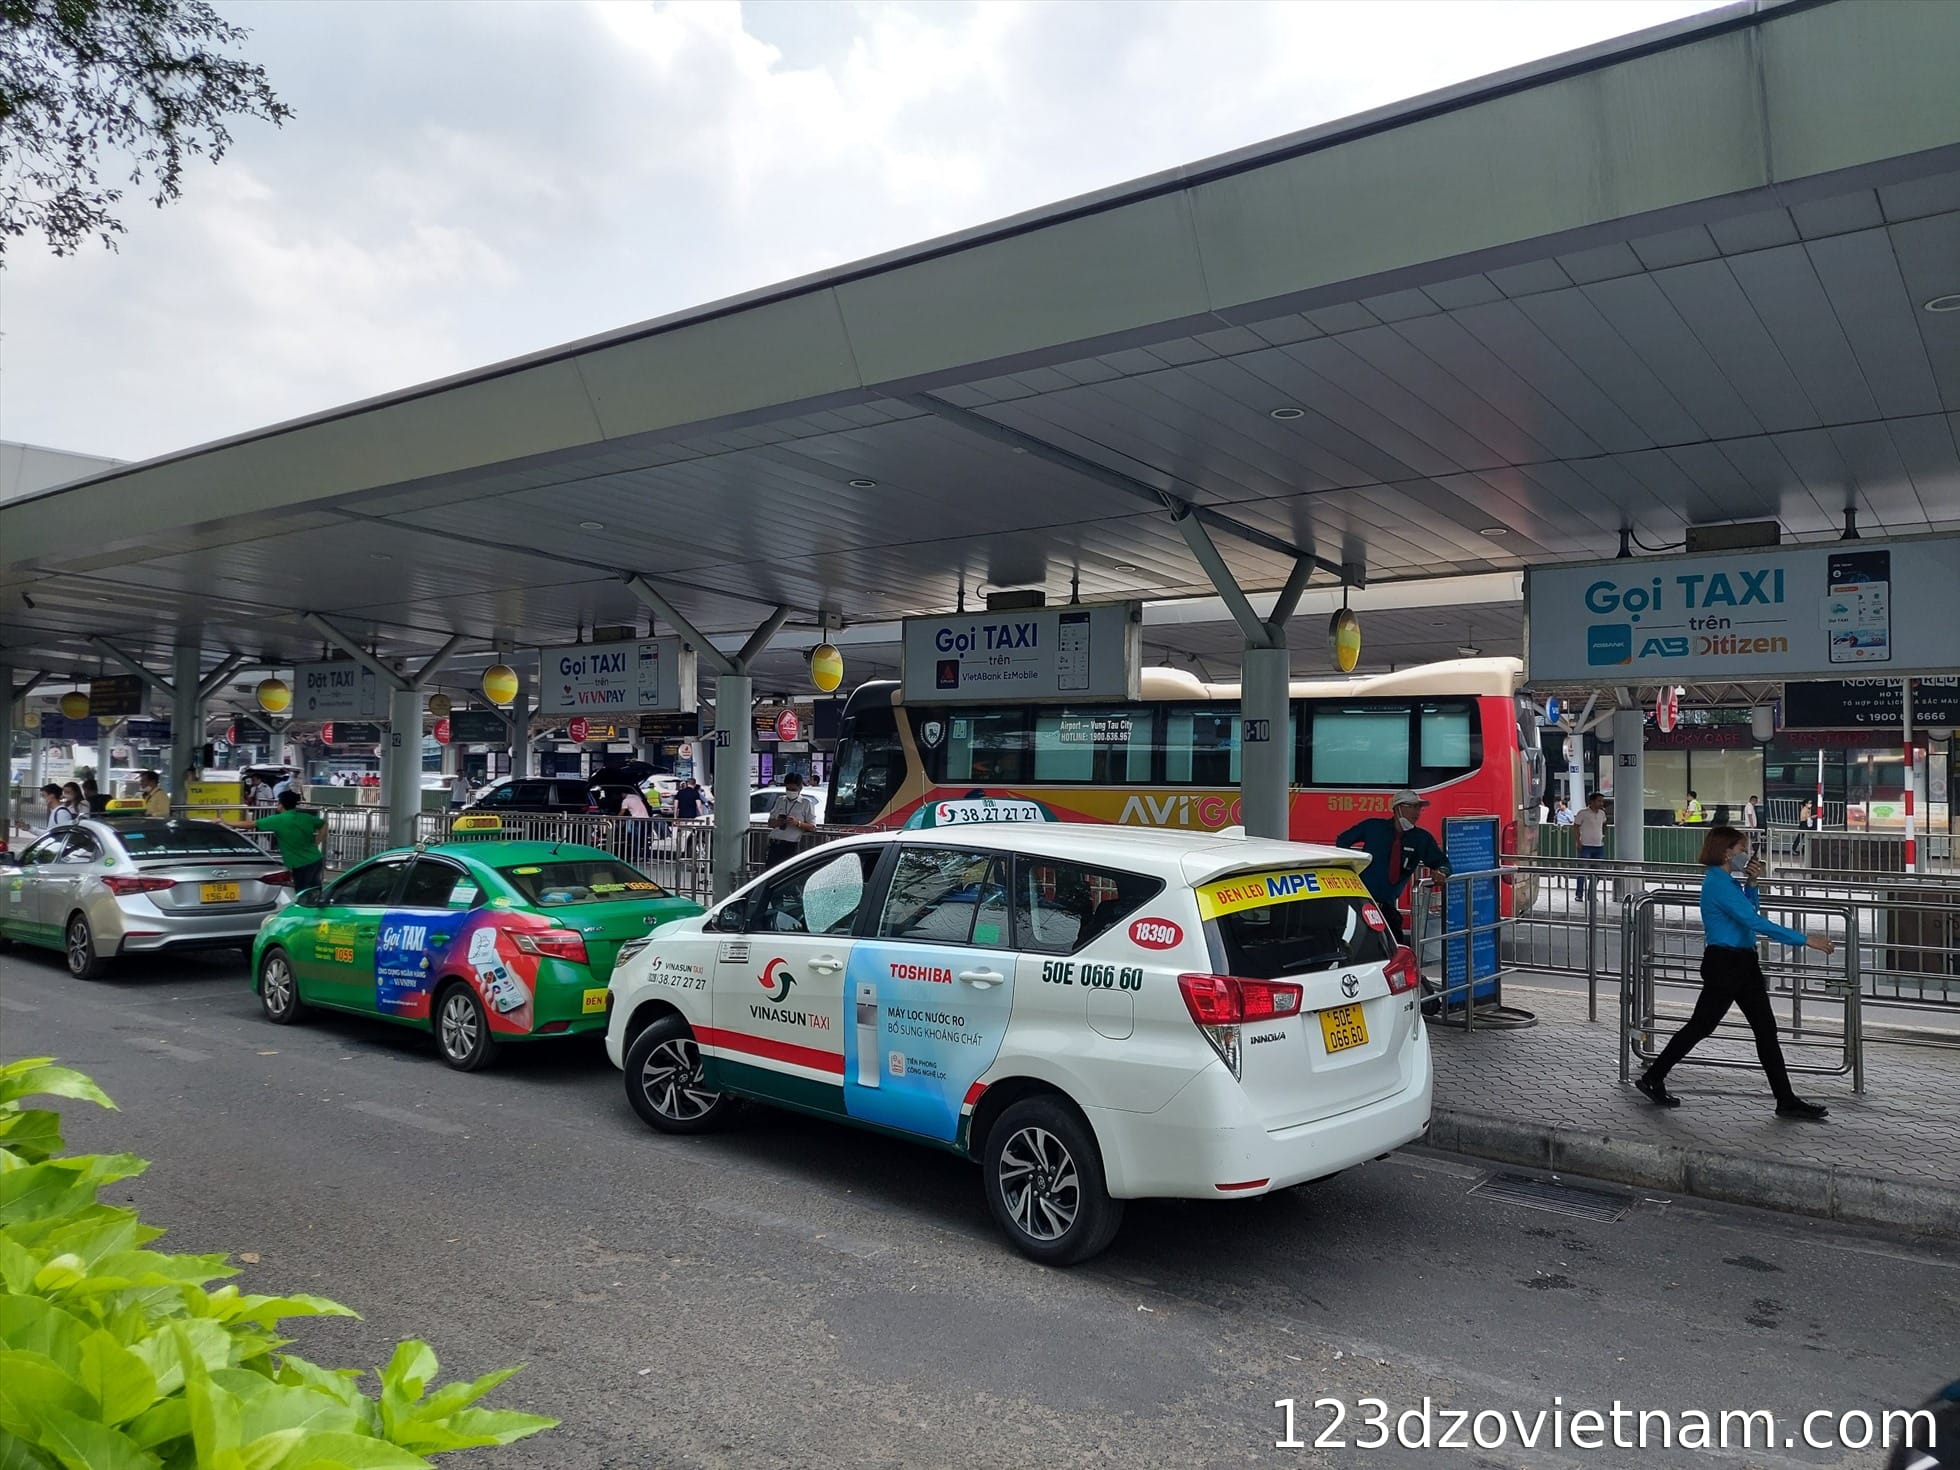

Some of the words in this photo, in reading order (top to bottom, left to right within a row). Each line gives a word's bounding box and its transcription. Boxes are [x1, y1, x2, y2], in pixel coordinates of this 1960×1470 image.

[1584, 577, 1662, 622] Gọi
[1676, 568, 1784, 609] TAXI
[1689, 614, 1731, 631] trên
[936, 625, 976, 659] Gọi
[982, 622, 1038, 650] TAXI
[560, 655, 586, 681] Gọi
[590, 652, 626, 674] TAXI
[988, 654, 1011, 666] trên
[329, 670, 354, 688] TAXI
[1003, 670, 1039, 680] EzMobile
[590, 688, 626, 704] VNPAY
[1060, 721, 1081, 732] Airport
[1091, 720, 1106, 731] Vung
[1107, 720, 1120, 730] Tau
[1120, 720, 1133, 731] City
[1869, 713, 1897, 721] 1900
[1916, 712, 1946, 721] 6666
[1061, 732, 1088, 741] HOTLINE:
[1244, 721, 1269, 741] C-10
[1003, 807, 1018, 820] 27
[1022, 807, 1037, 820] 27
[1216, 886, 1242, 905] ĐÈN
[1244, 883, 1264, 899] LED
[1266, 872, 1321, 898] MPE
[383, 927, 402, 951] Gọi
[402, 925, 427, 952] TAXI
[1136, 922, 1176, 944] 18390
[665, 962, 692, 973] VINASUN
[889, 963, 953, 984] TOSHIBA
[1042, 960, 1075, 986] 50E
[1080, 963, 1115, 989] 066
[1119, 966, 1143, 992] 60
[682, 976, 694, 988] 27
[695, 978, 707, 990] 27
[750, 1004, 806, 1026] VINASUN
[807, 1013, 830, 1031] TAXI
[887, 1006, 906, 1019] MÁY
[907, 1009, 923, 1023] LỌC
[925, 1011, 951, 1025] NƯỚC
[952, 1015, 965, 1027] RO
[1334, 1007, 1353, 1028] 50E
[900, 1024, 923, 1037] SUNG
[924, 1029, 960, 1043] KHOÁNG
[961, 1032, 983, 1046] CHẤT
[1250, 1031, 1287, 1045] INNOVA
[1329, 1025, 1364, 1049] 066.60
